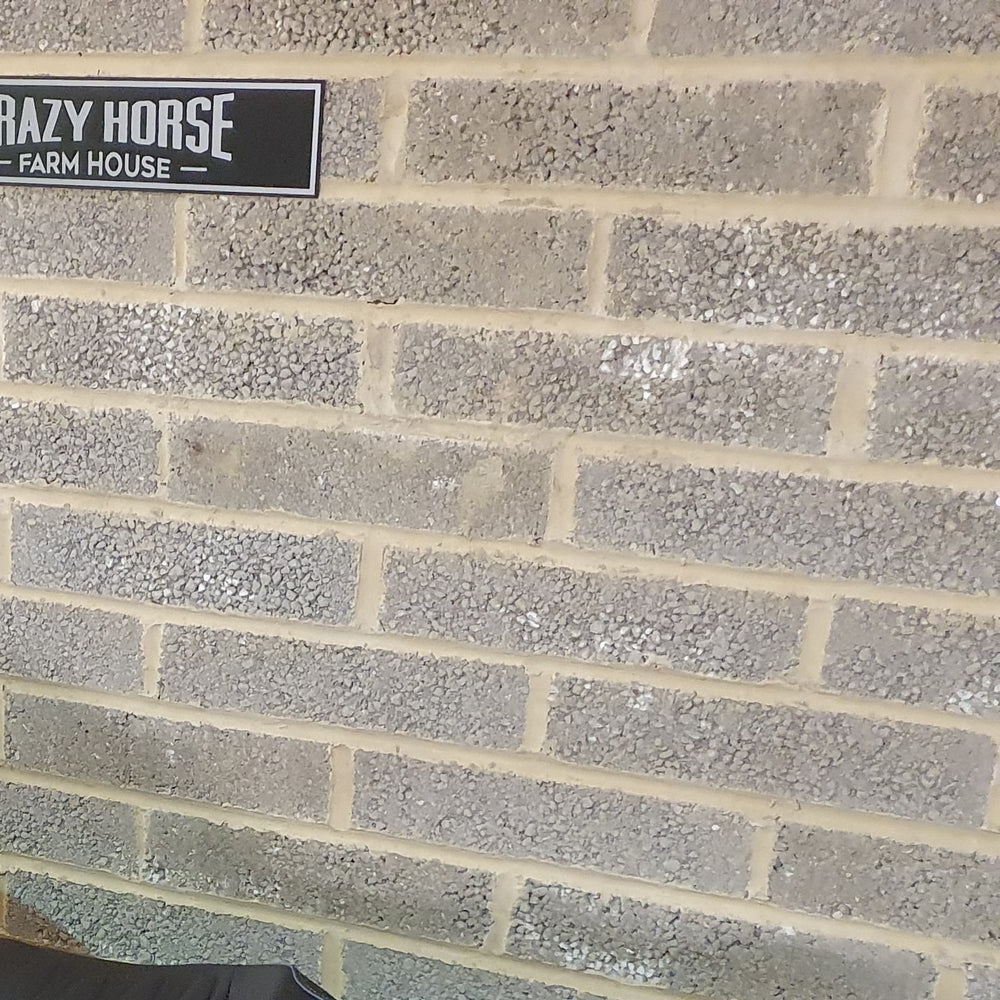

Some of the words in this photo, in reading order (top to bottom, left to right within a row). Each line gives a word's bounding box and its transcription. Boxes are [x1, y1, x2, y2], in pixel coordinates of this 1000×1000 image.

[103, 92, 235, 161] HORSE
[18, 150, 80, 176] FARM
[87, 151, 171, 179] HOUSE
